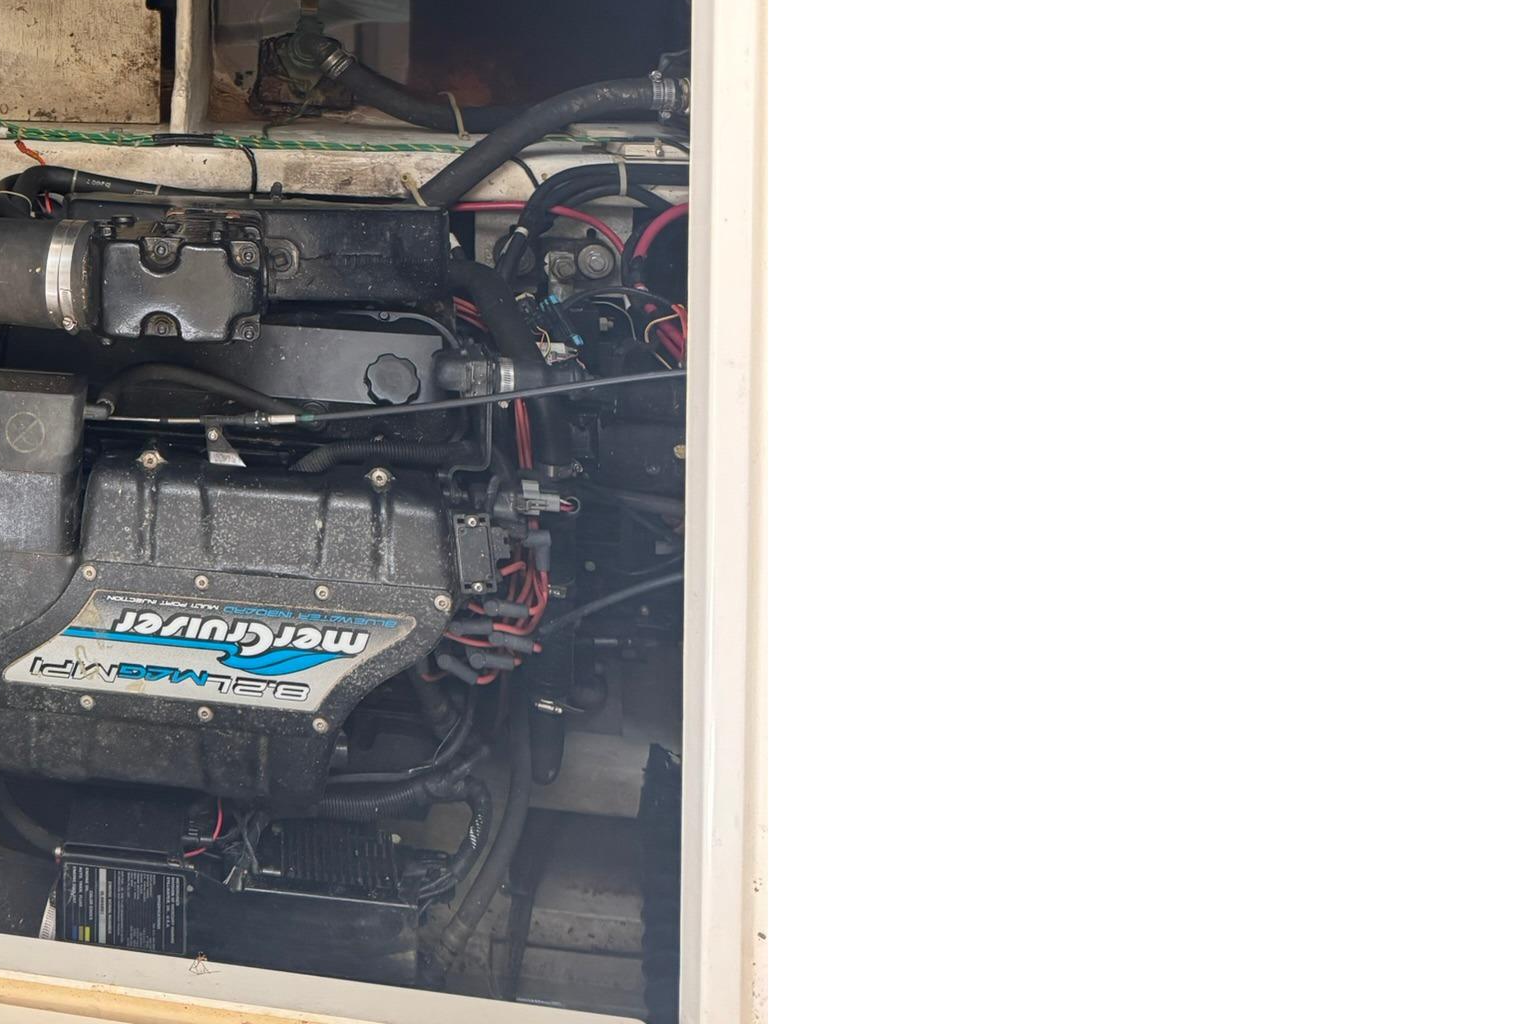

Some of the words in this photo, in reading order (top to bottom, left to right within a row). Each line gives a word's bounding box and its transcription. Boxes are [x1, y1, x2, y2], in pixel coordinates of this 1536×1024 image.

[106, 595, 157, 605] INJECTION
[223, 605, 293, 619] INBOARD
[298, 612, 398, 629] BLUEWATER
